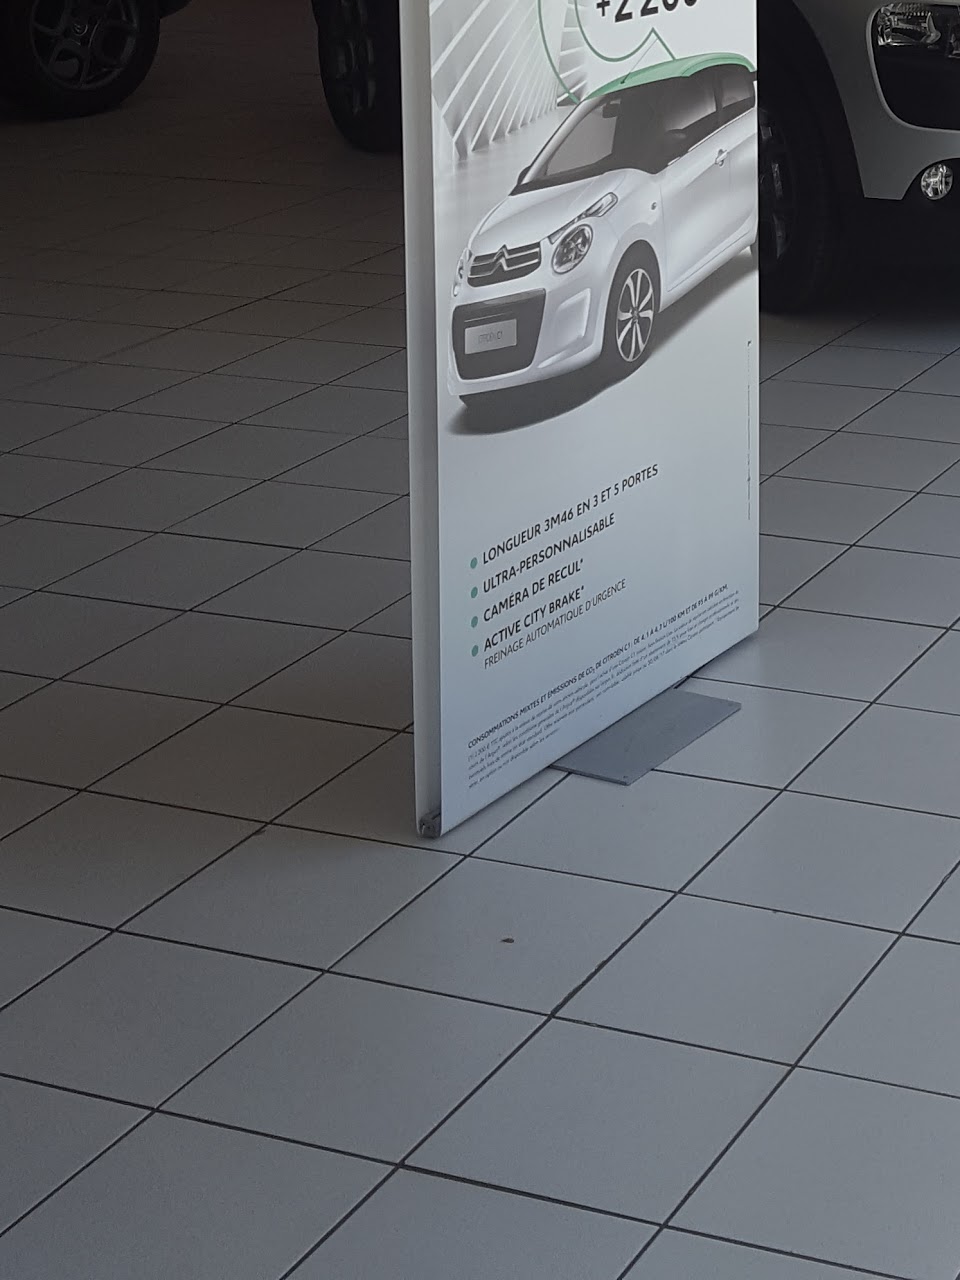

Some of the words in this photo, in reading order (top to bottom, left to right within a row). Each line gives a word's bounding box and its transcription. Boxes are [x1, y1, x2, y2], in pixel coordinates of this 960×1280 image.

[483, 523, 541, 564] LONGUEUR
[544, 508, 574, 532] 3M46
[577, 499, 591, 517] EN
[593, 495, 599, 508] 3
[601, 487, 612, 503] ET
[614, 483, 620, 496] 5
[622, 463, 658, 492] PORTES
[483, 512, 616, 594] ULTRA-PERSONNALISABLE
[483, 587, 530, 622] CAMÉRA
[532, 577, 545, 595] DE
[483, 619, 522, 652] ACTIVE
[523, 604, 547, 628] CITY
[484, 637, 524, 670] FREINAGE
[526, 604, 584, 646] AUTOMATIQUE
[585, 578, 627, 612] D'URGENCE
[467, 711, 519, 749] CONSOMMATIONS
[519, 698, 540, 716] MIXTES
